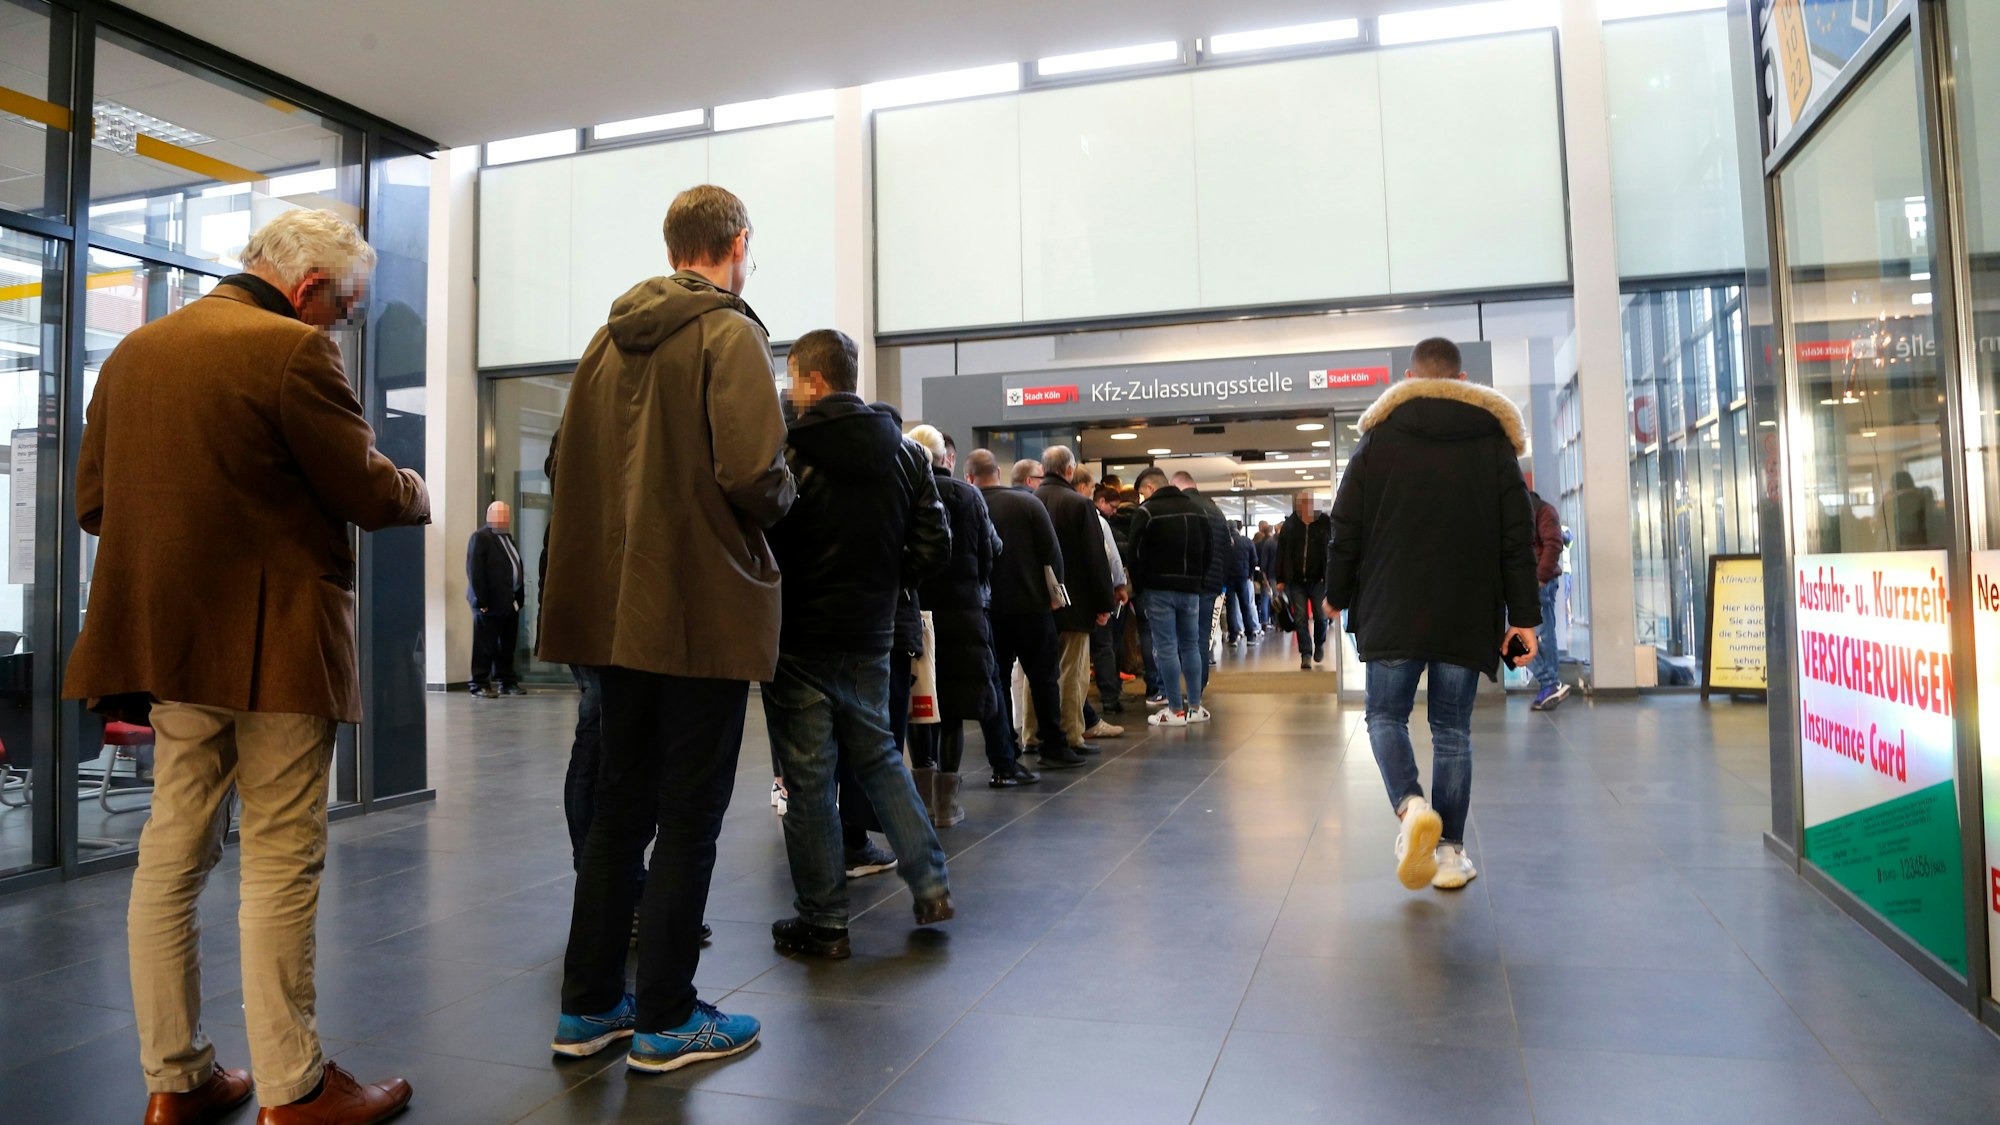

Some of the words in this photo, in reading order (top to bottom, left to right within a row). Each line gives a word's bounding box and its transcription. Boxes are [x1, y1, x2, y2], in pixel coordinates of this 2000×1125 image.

[1328, 373, 1351, 384] Stadt
[1351, 372, 1370, 383] Köln
[1091, 371, 1293, 402] Kfz-Zulassungsstelle
[1024, 392, 1043, 401] Stadt
[1044, 390, 1061, 400] Köln
[1800, 566, 1850, 613] Ausfuhr-
[1855, 584, 1869, 616] u.
[1873, 567, 1951, 624] Kurzzeit-
[1977, 573, 2000, 612] Ne
[1722, 604, 1740, 612] Hier
[1729, 617, 1743, 625] Sie
[1719, 630, 1732, 638] die
[1734, 657, 1760, 665] sehen
[1801, 629, 1956, 719] VERSICHERUNGEN
[1803, 699, 1865, 765] Insurance
[1869, 722, 1906, 783] Card
